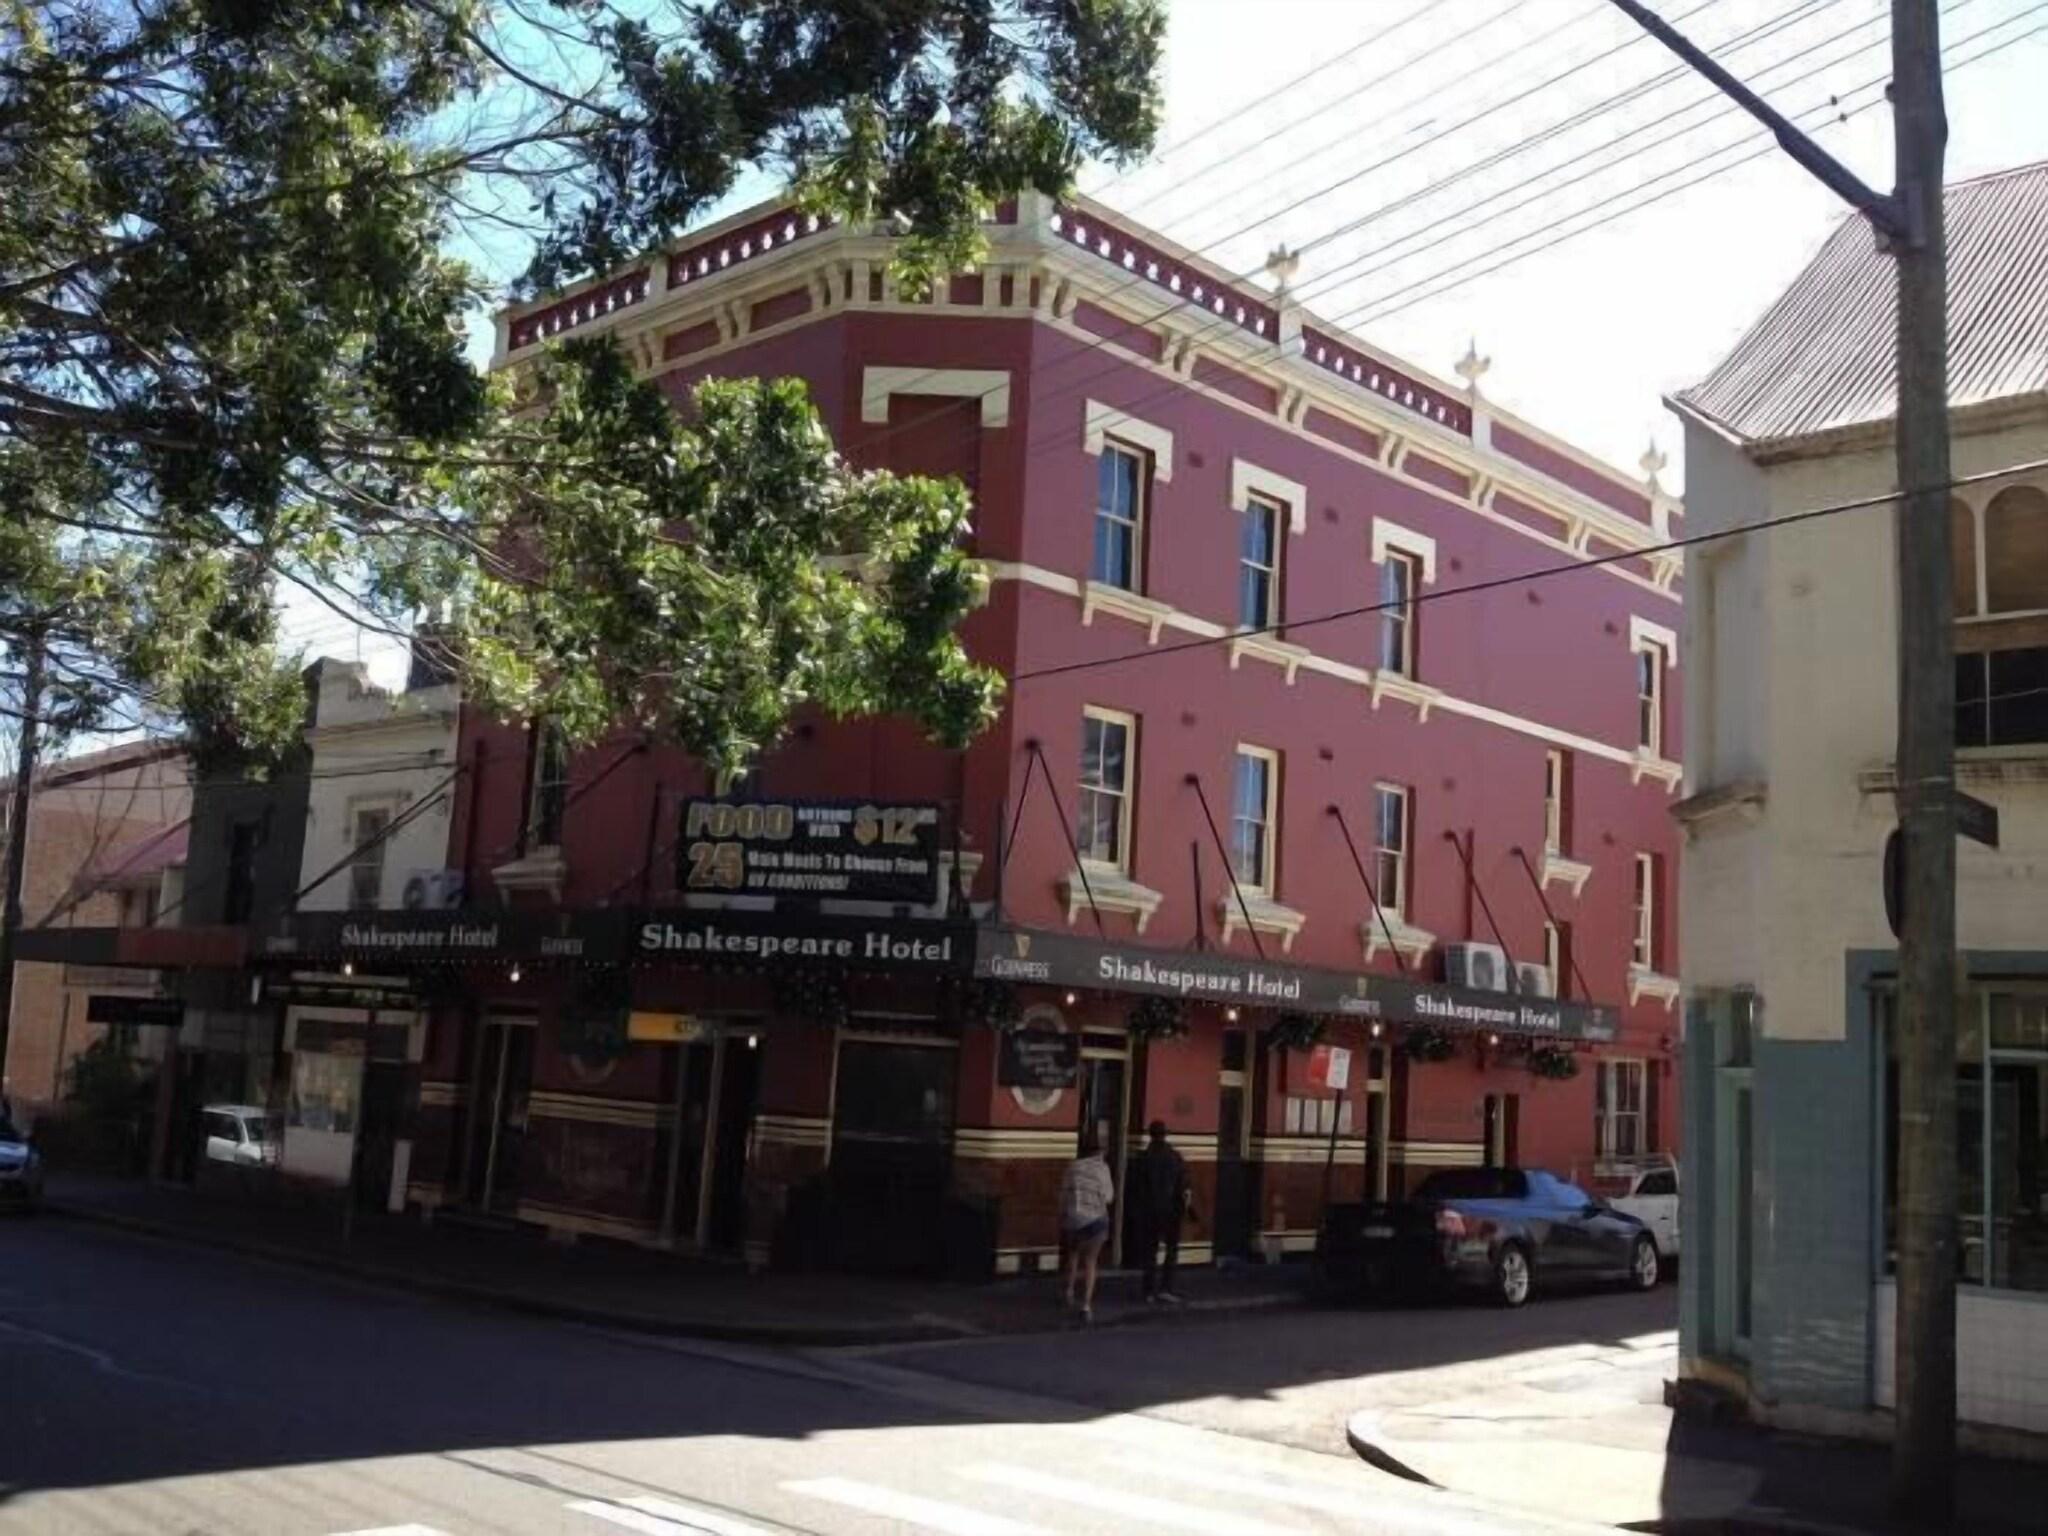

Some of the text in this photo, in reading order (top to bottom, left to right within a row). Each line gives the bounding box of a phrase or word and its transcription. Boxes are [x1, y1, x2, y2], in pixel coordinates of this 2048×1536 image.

[686, 802, 794, 840] FOOD
[687, 841, 744, 888] 25
[341, 922, 498, 950] Shakespeare Hotel
[641, 923, 952, 960] Shakespeare Hotel
[1098, 955, 1300, 999] Shakespeare Hotel
[1415, 994, 1561, 1030] Shakespeare Hotel
